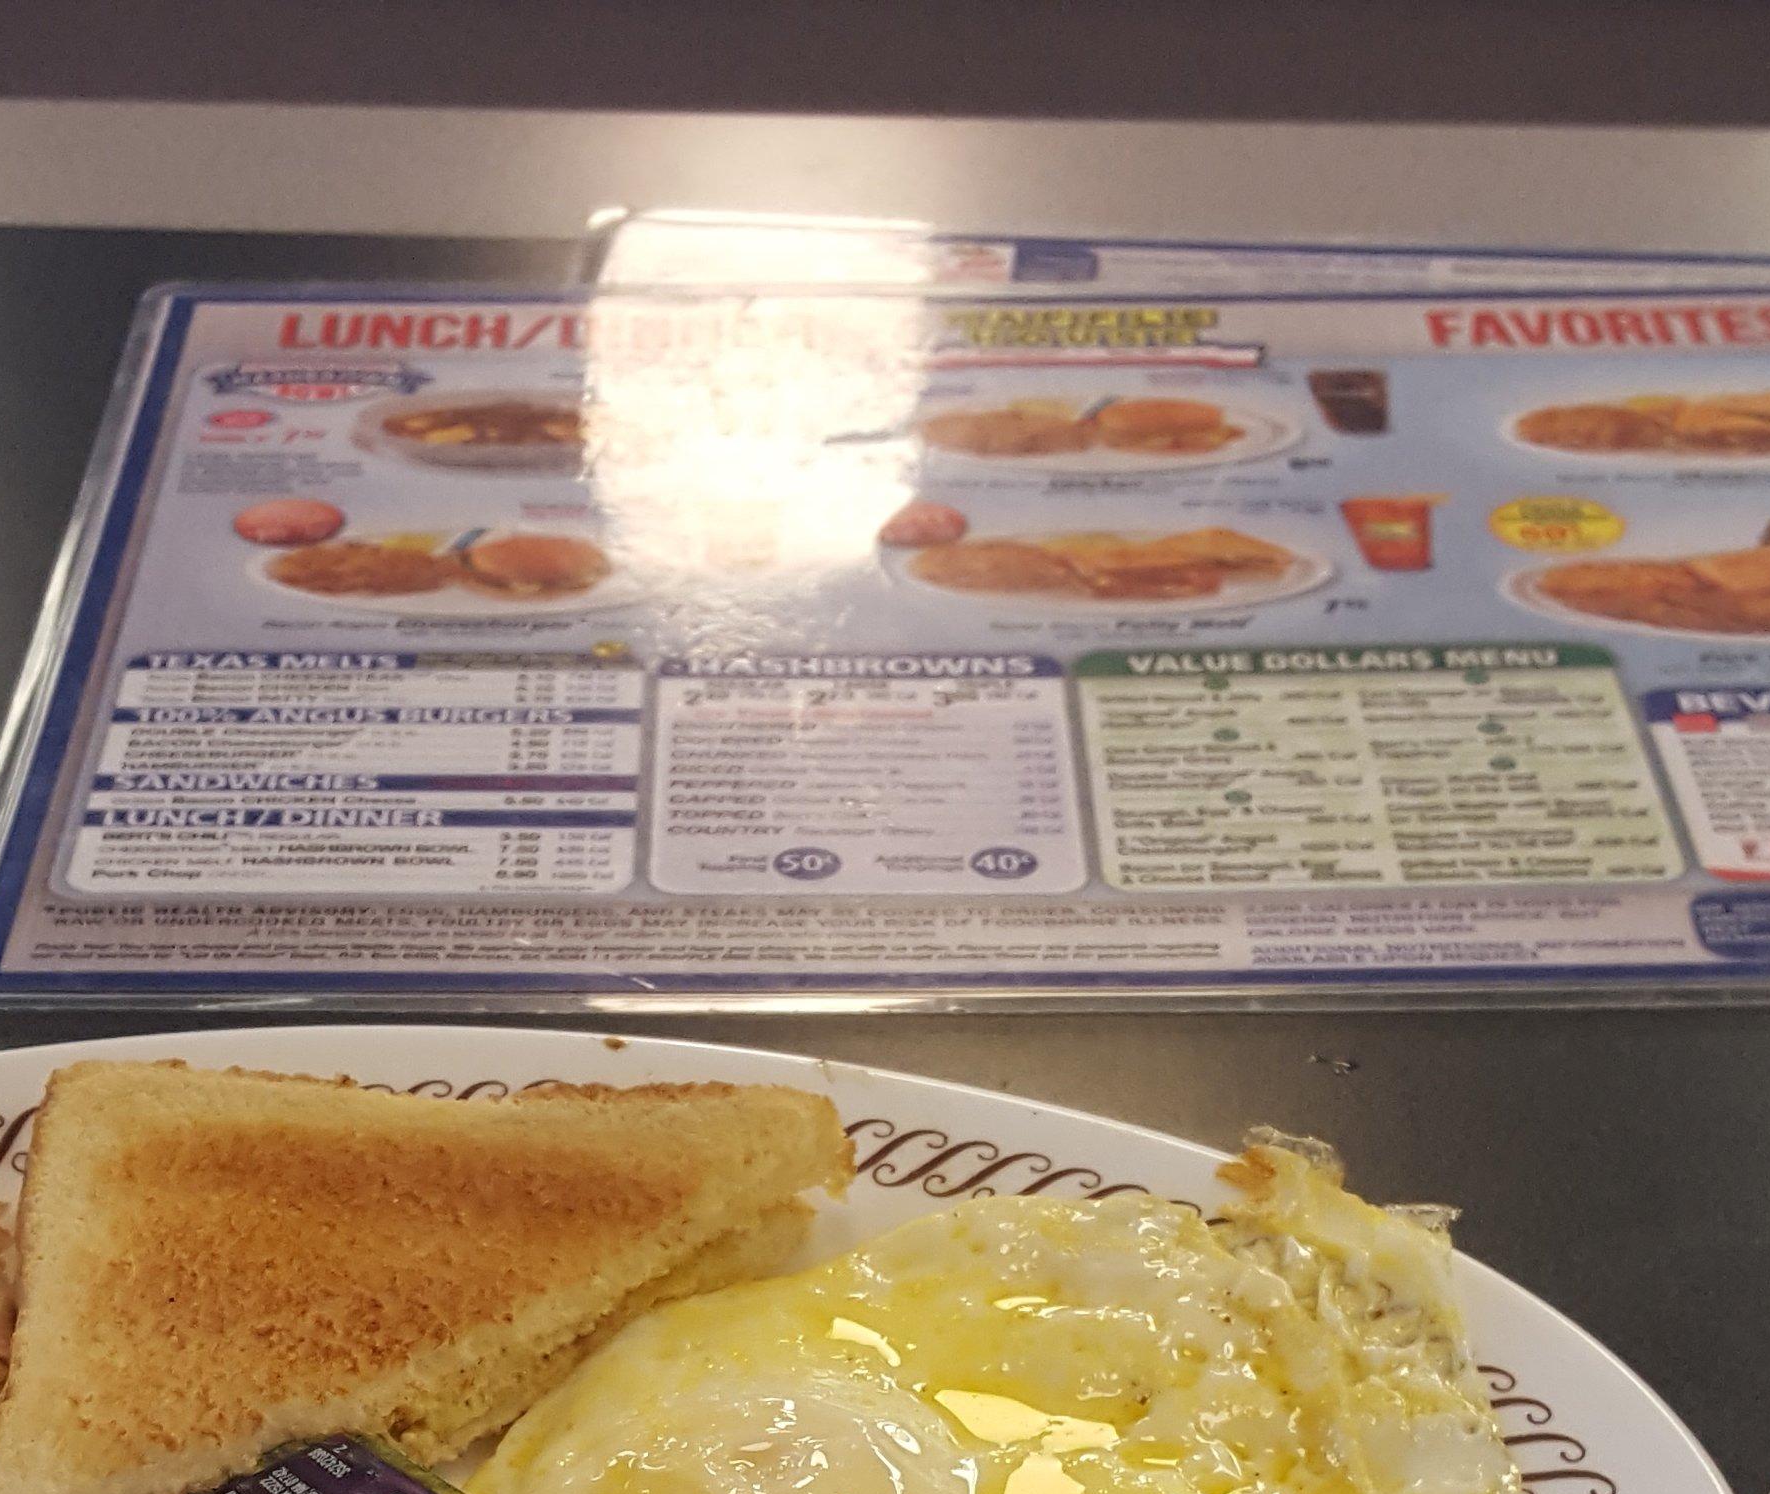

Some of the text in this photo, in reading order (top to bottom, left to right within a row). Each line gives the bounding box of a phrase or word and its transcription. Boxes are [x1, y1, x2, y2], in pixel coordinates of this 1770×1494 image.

[148, 653, 400, 669] TEXAS MELTS
[691, 657, 1035, 676] HASHBROWNS
[1129, 654, 1253, 673] VALUE
[1444, 649, 1558, 667] MENU
[135, 706, 573, 724] 100% ANGUS BURGERS
[113, 774, 379, 791] SANDWICHES
[103, 810, 245, 826] LUNCH
[280, 810, 443, 826] DINNER
[258, 1475, 286, 1494] 15222
